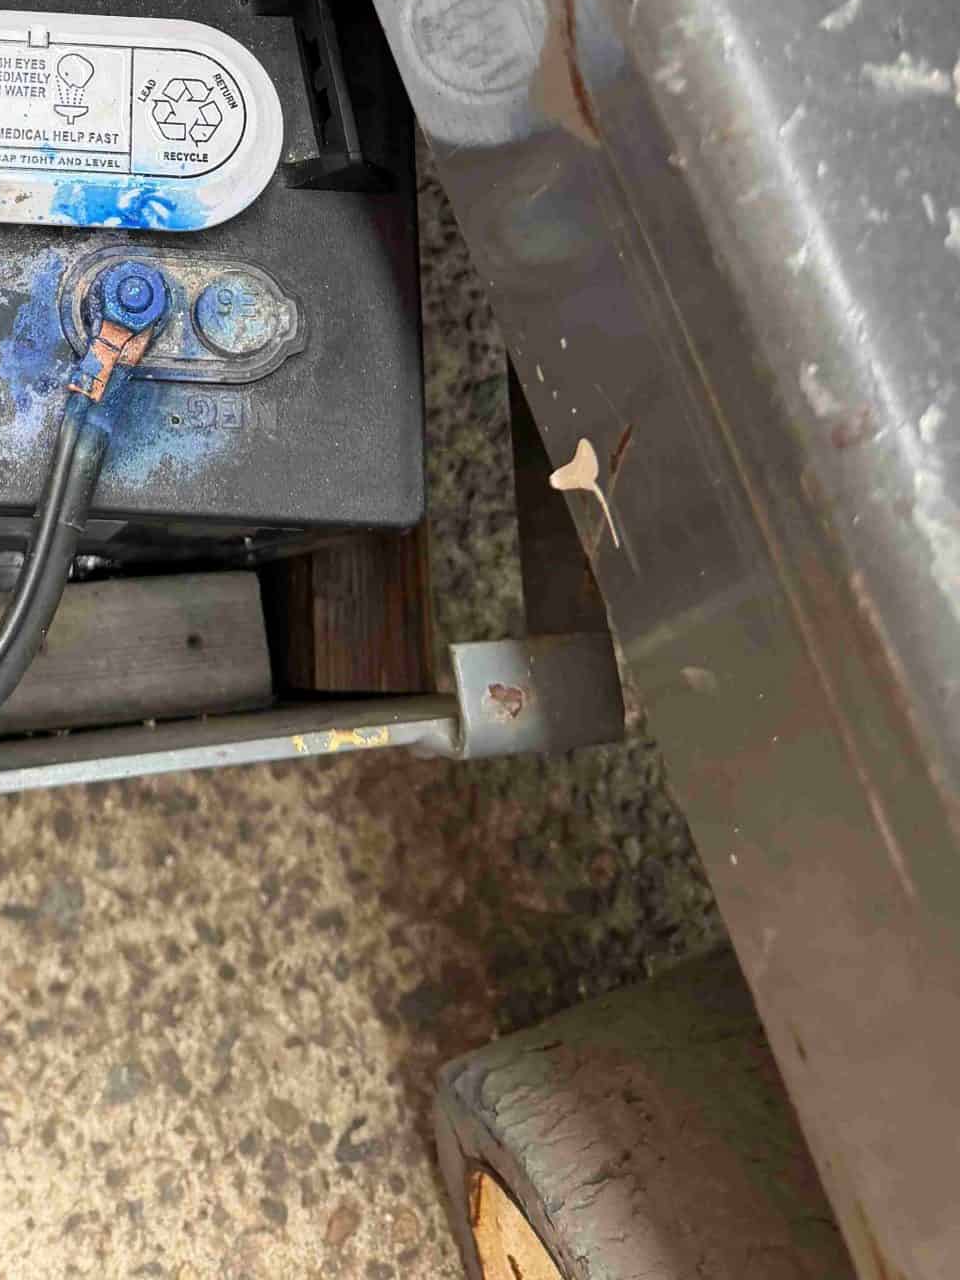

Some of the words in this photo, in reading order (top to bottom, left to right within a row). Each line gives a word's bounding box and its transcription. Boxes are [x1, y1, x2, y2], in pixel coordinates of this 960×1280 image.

[15, 57, 47, 71] EYES
[4, 83, 47, 99] WATER
[137, 79, 157, 103] LEAD
[213, 72, 240, 110] RETURN
[52, 130, 86, 143] HELP
[87, 131, 120, 145] FAST
[20, 154, 55, 166] TIGHT
[58, 155, 82, 167] AND
[85, 157, 122, 169] LEVEL
[162, 150, 209, 163] RECYCLE
